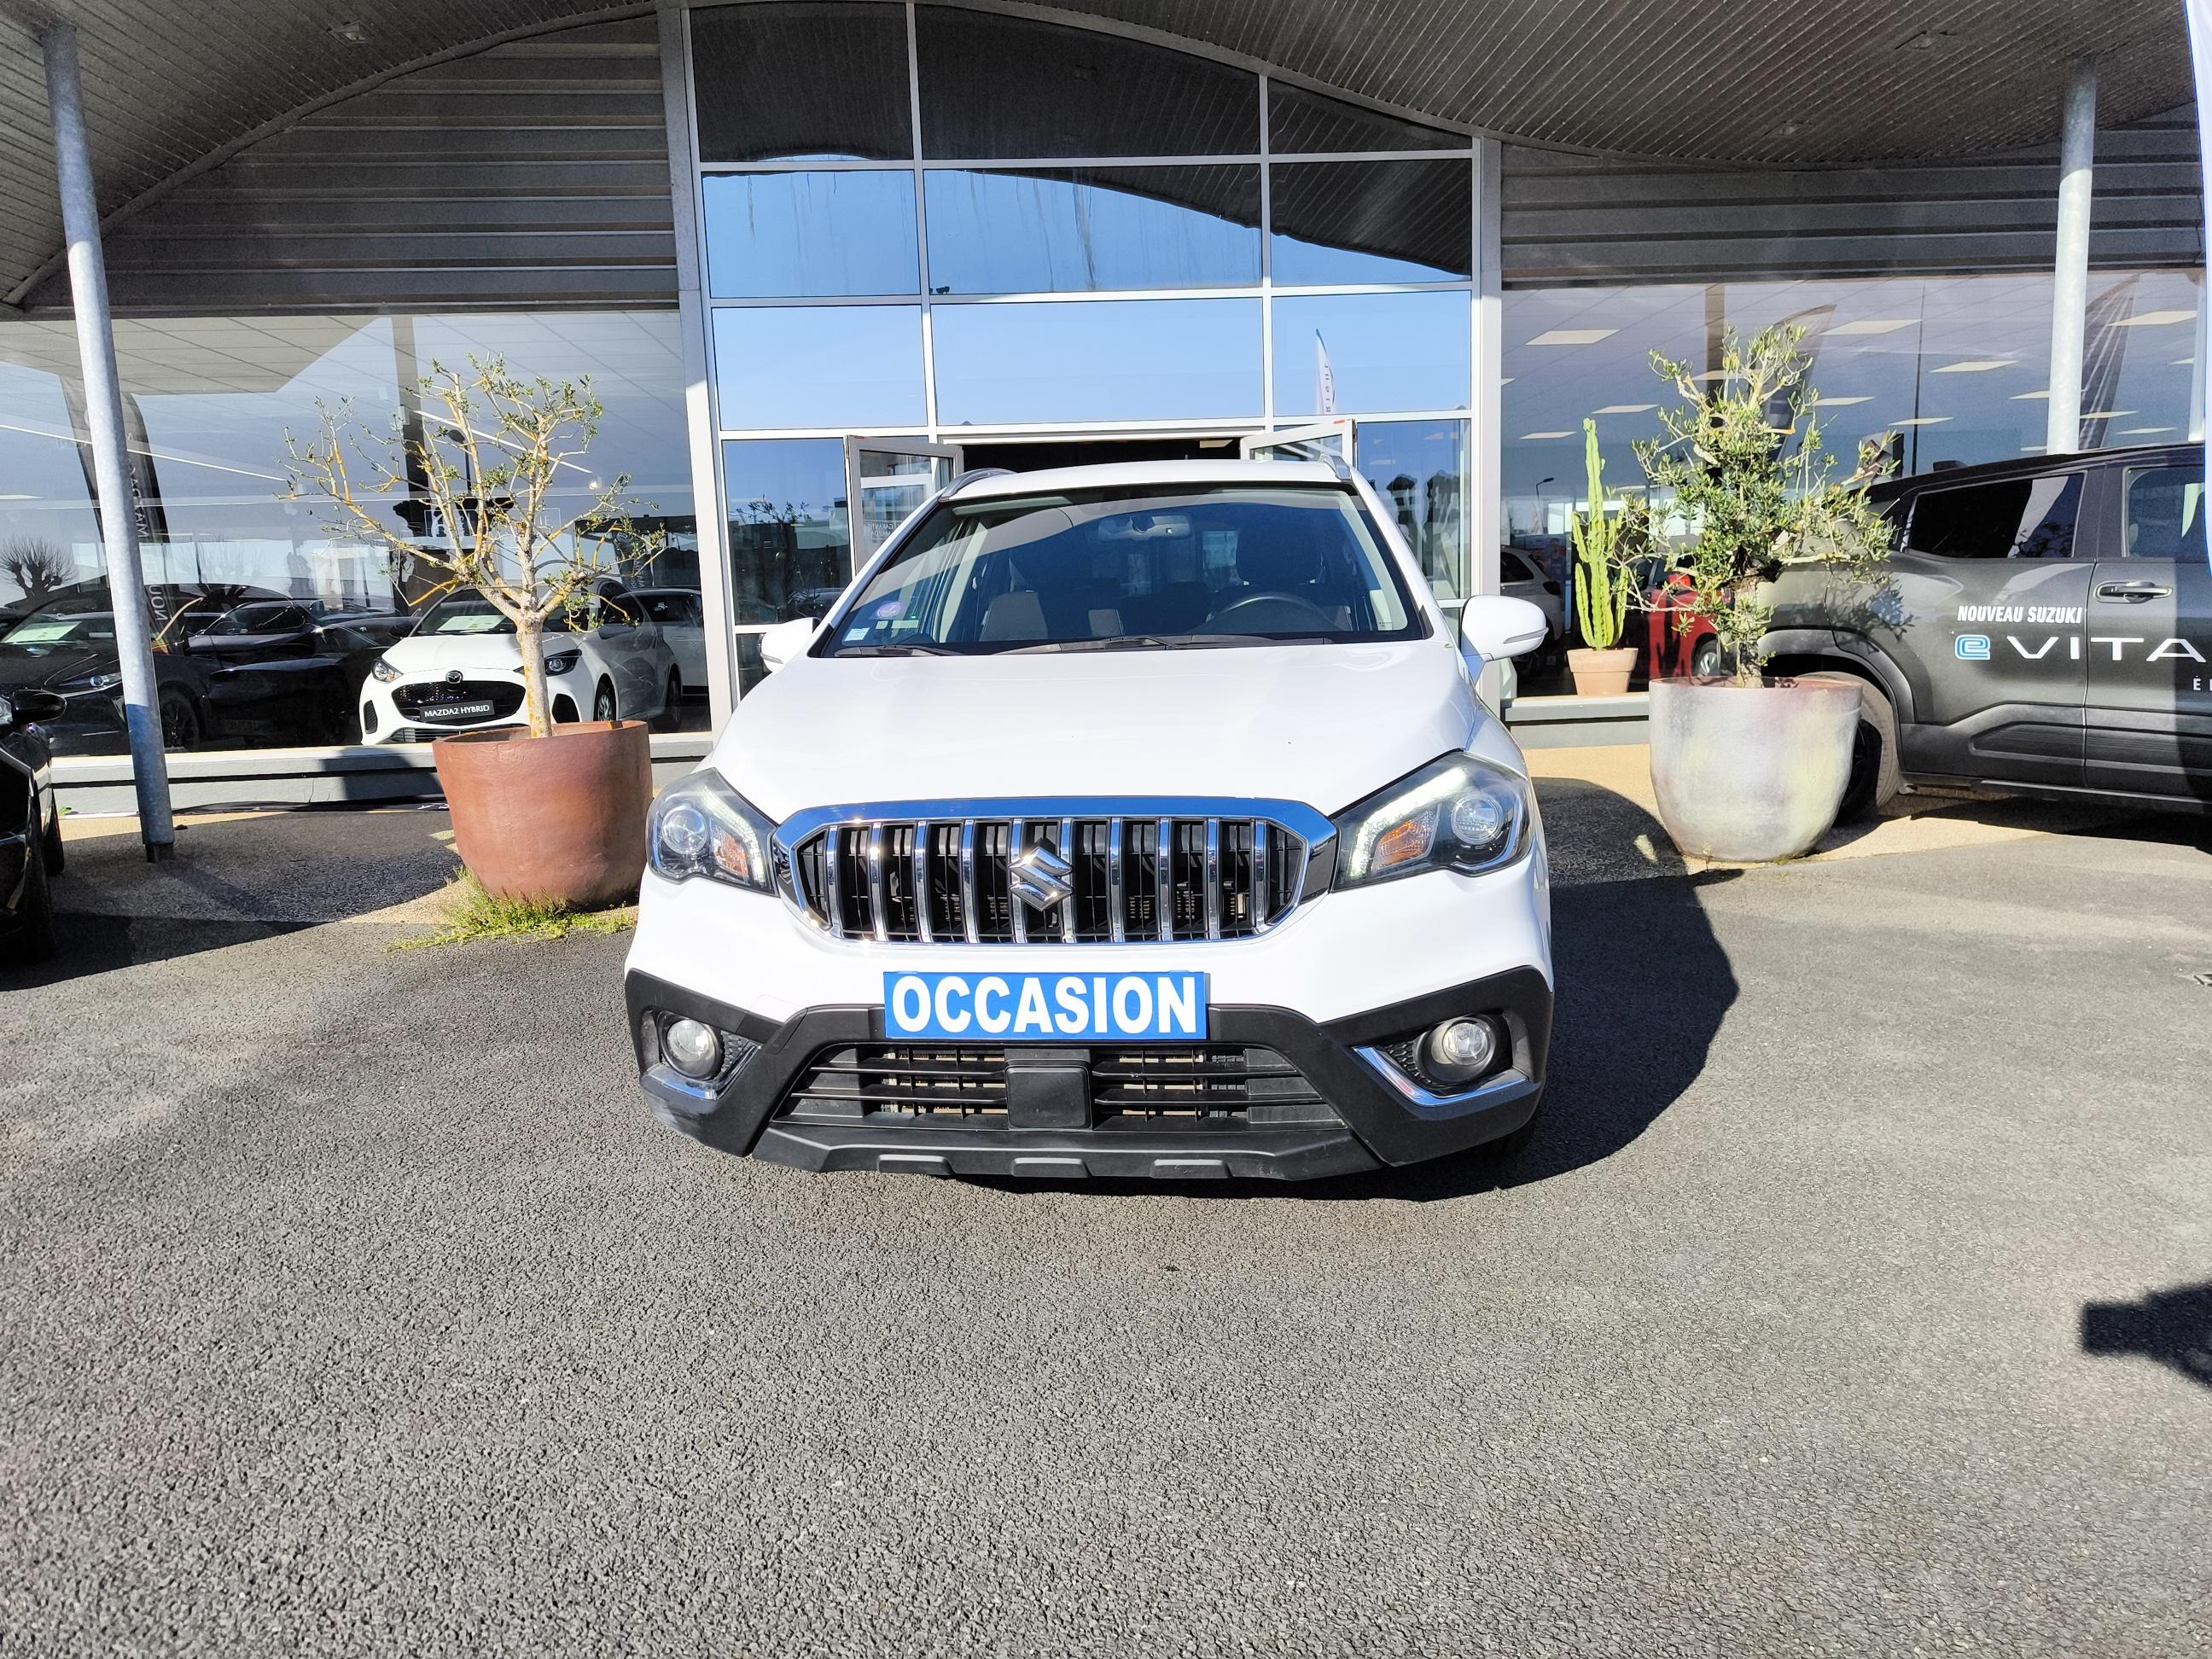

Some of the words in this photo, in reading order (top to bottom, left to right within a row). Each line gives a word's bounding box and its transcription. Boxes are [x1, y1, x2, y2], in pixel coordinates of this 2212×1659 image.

[1957, 605, 2023, 623] NOUVEAU
[2027, 607, 2082, 624] SUZUKI
[424, 707, 459, 717] MAZDA2
[460, 704, 490, 714] HYBRID
[892, 975, 1196, 1033] OCCASION
